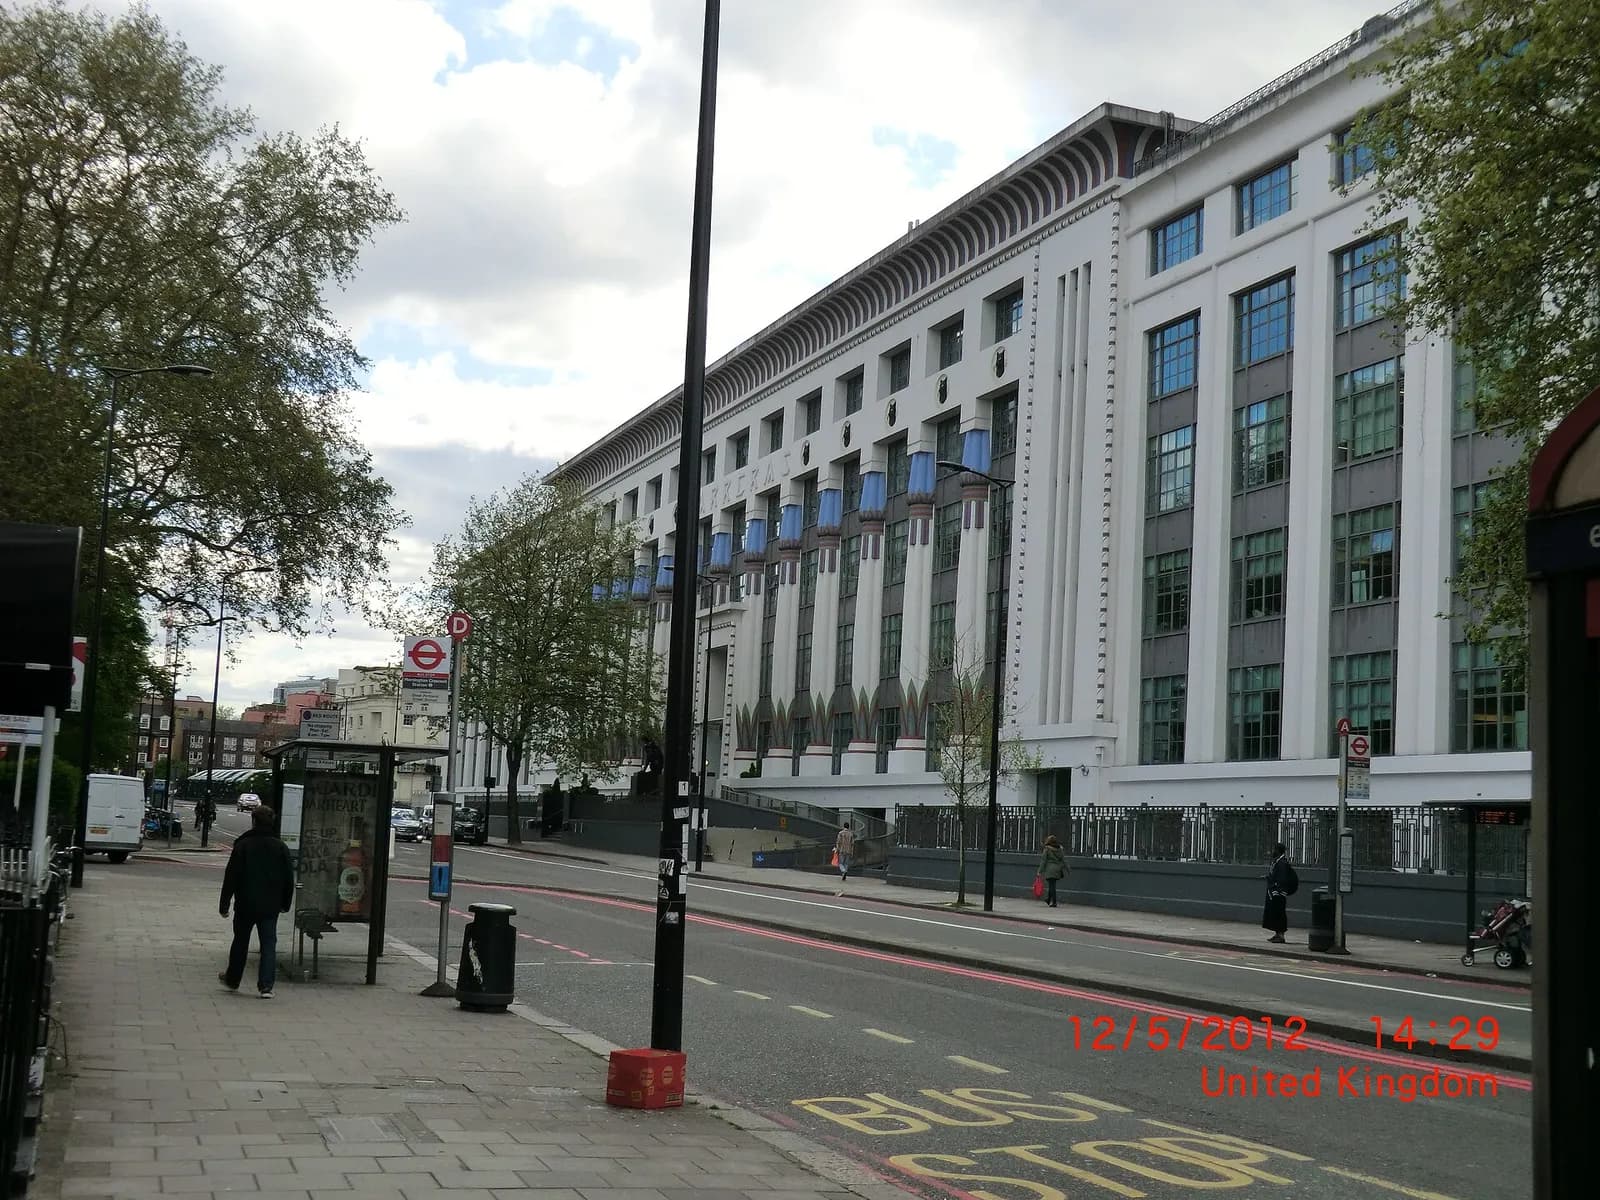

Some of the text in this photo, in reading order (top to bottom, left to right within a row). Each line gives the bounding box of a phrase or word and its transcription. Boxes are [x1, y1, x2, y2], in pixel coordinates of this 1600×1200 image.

[453, 617, 467, 634] D
[1341, 721, 1350, 732] A
[792, 1088, 1097, 1135] BUS
[889, 1137, 1295, 1200] STOP
